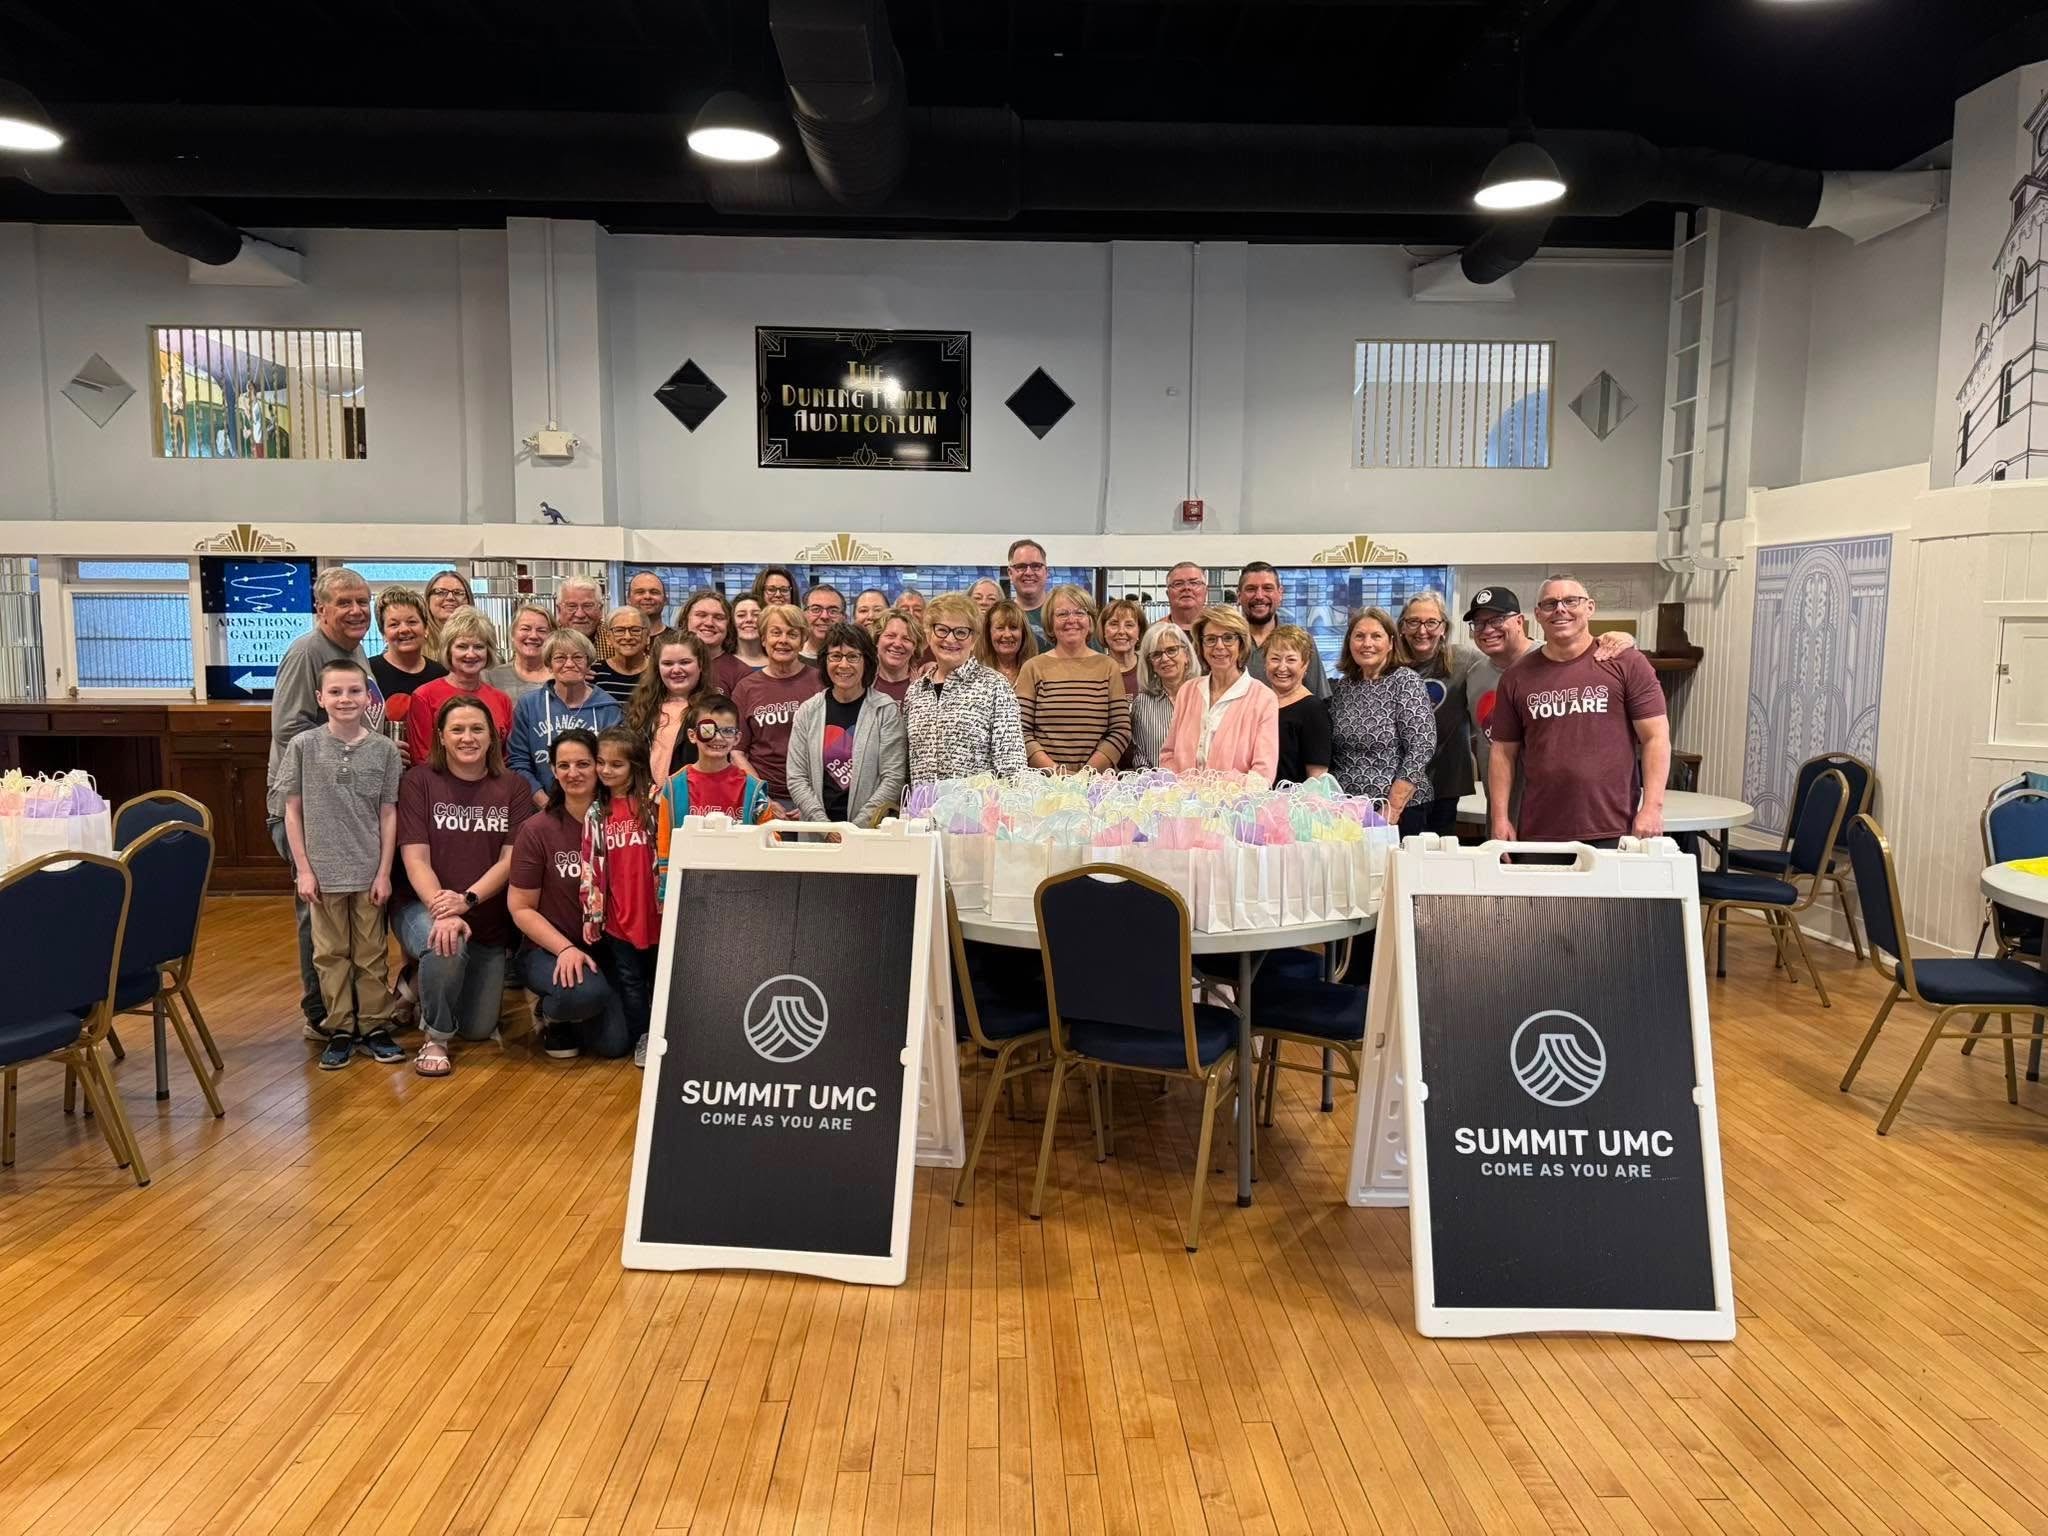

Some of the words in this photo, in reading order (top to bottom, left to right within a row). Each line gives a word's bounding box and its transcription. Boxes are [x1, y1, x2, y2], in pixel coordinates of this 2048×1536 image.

[782, 384, 864, 409] DUNING
[794, 410, 937, 434] AUDITORIUM
[216, 617, 304, 627] ARMSTRONG
[230, 630, 293, 640] GALLERY
[253, 642, 272, 650] OF
[238, 653, 285, 663] FLIGH
[1527, 687, 1579, 707] COME
[1581, 684, 1609, 701] AS
[754, 700, 800, 716] COME
[1528, 700, 1567, 719] YOU
[1568, 697, 1609, 714] ARE
[754, 710, 789, 728] YOU
[826, 758, 841, 771] Do
[433, 802, 485, 821] COME
[486, 806, 510, 820] AS
[433, 814, 470, 832] YOU
[472, 817, 510, 833] ARE
[606, 829, 626, 850] OU
[555, 863, 582, 878] YO
[681, 1079, 802, 1108] SUMMIT
[809, 1084, 877, 1112] UMC
[700, 1112, 747, 1126] COME
[752, 1114, 774, 1127] AS
[780, 1115, 814, 1129] YOU
[818, 1117, 853, 1131] ARE
[1454, 1127, 1589, 1156] SUMMIT
[1598, 1130, 1674, 1157] UMC
[1481, 1162, 1534, 1177] COME
[1539, 1163, 1565, 1177] AS
[1570, 1164, 1608, 1178] YOU
[1615, 1164, 1652, 1178] ARE
